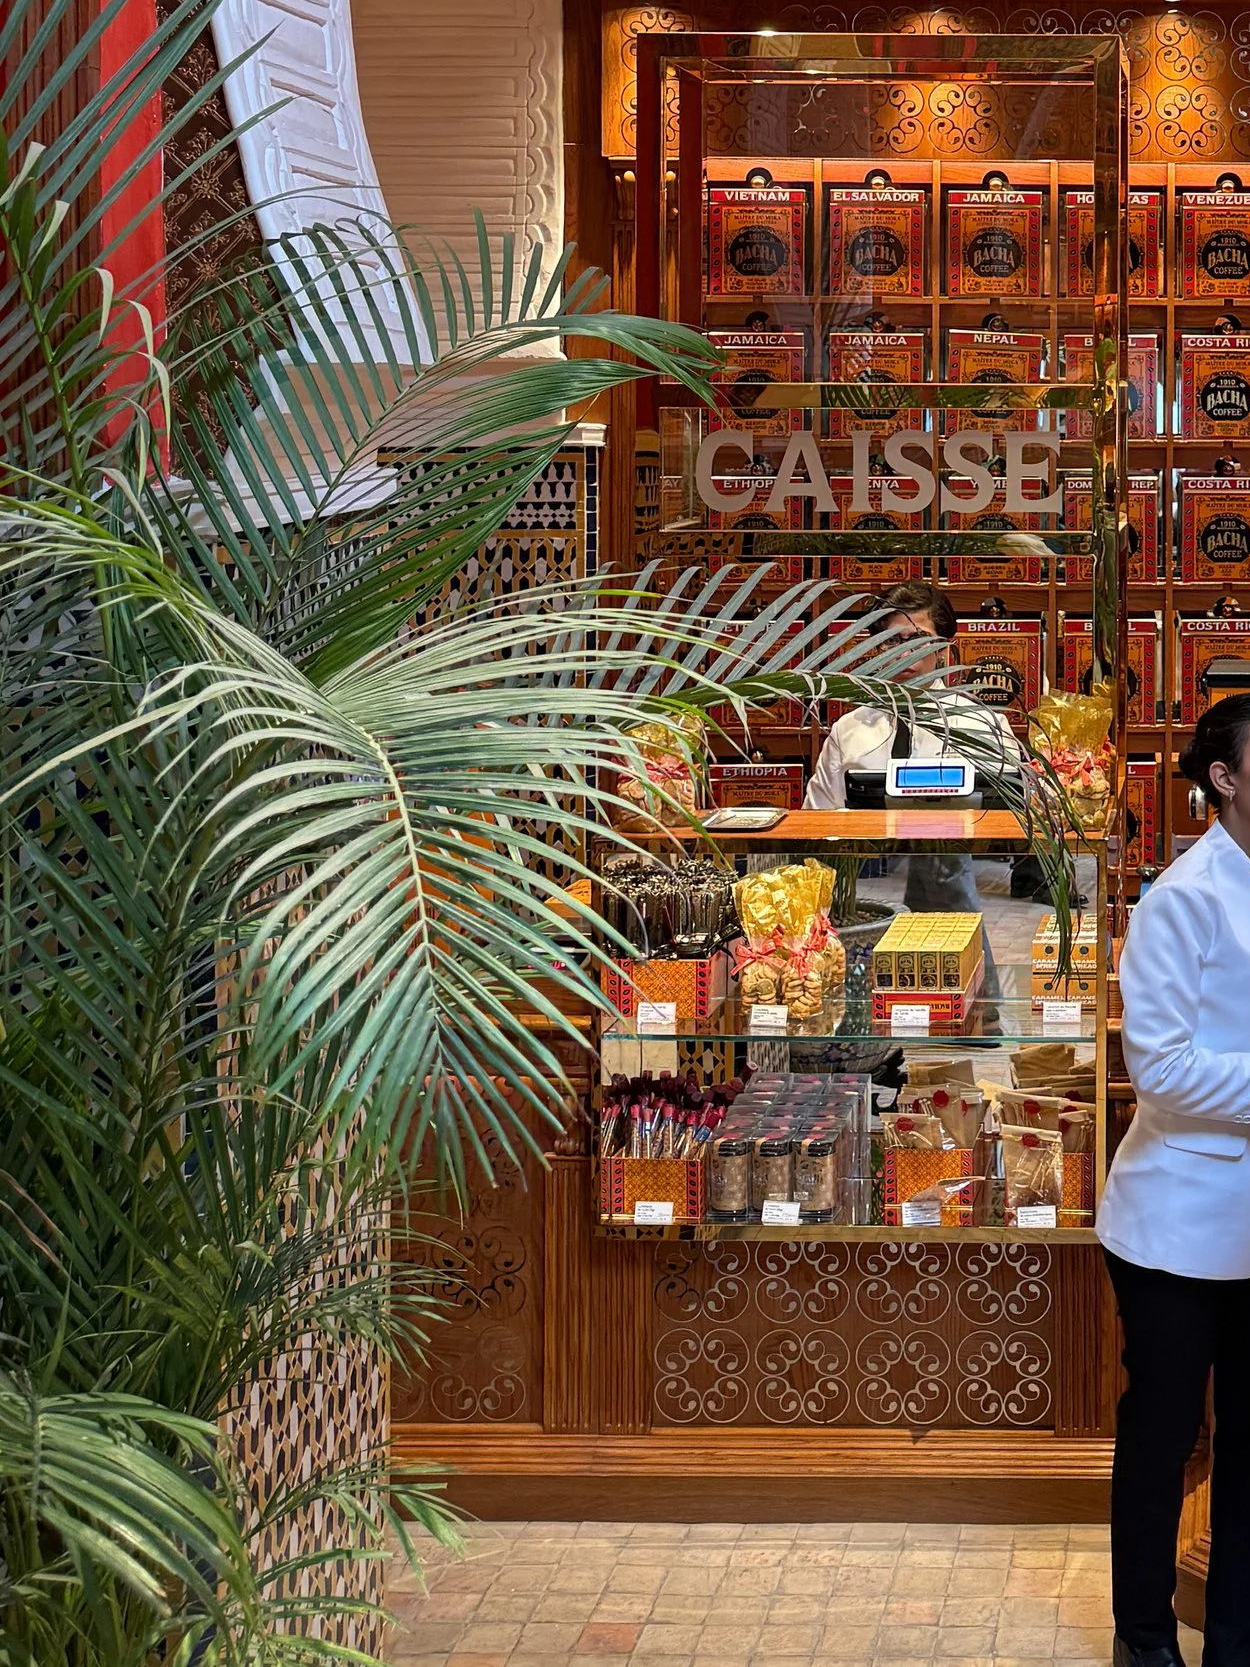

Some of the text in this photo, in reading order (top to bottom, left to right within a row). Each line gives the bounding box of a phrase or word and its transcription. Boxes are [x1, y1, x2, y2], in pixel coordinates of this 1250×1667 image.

[725, 190, 790, 202] VIETNAM
[833, 191, 919, 203] EL SALVADOR
[963, 192, 1025, 204] JAMAICA
[1077, 195, 1148, 204] HOAS
[973, 245, 1015, 268] BACHA
[1208, 248, 1249, 270] BACHA
[980, 264, 1009, 272] COFFEE
[1214, 266, 1243, 274] COFFEE
[725, 336, 787, 344] JAMAICA
[845, 334, 907, 345] JAMAICA
[974, 333, 1018, 345] NEPAL
[1188, 338, 1230, 348] COSTA
[1206, 390, 1248, 411] BACHA
[1212, 408, 1241, 416] COFFEE
[696, 429, 1064, 514] CAISSE
[724, 478, 775, 489] ETHIOP
[1188, 479, 1231, 490] COSTA
[968, 623, 1020, 631] BRAZIL
[1188, 621, 1229, 632] COSTA
[723, 768, 787, 777] ETHIOPIA
